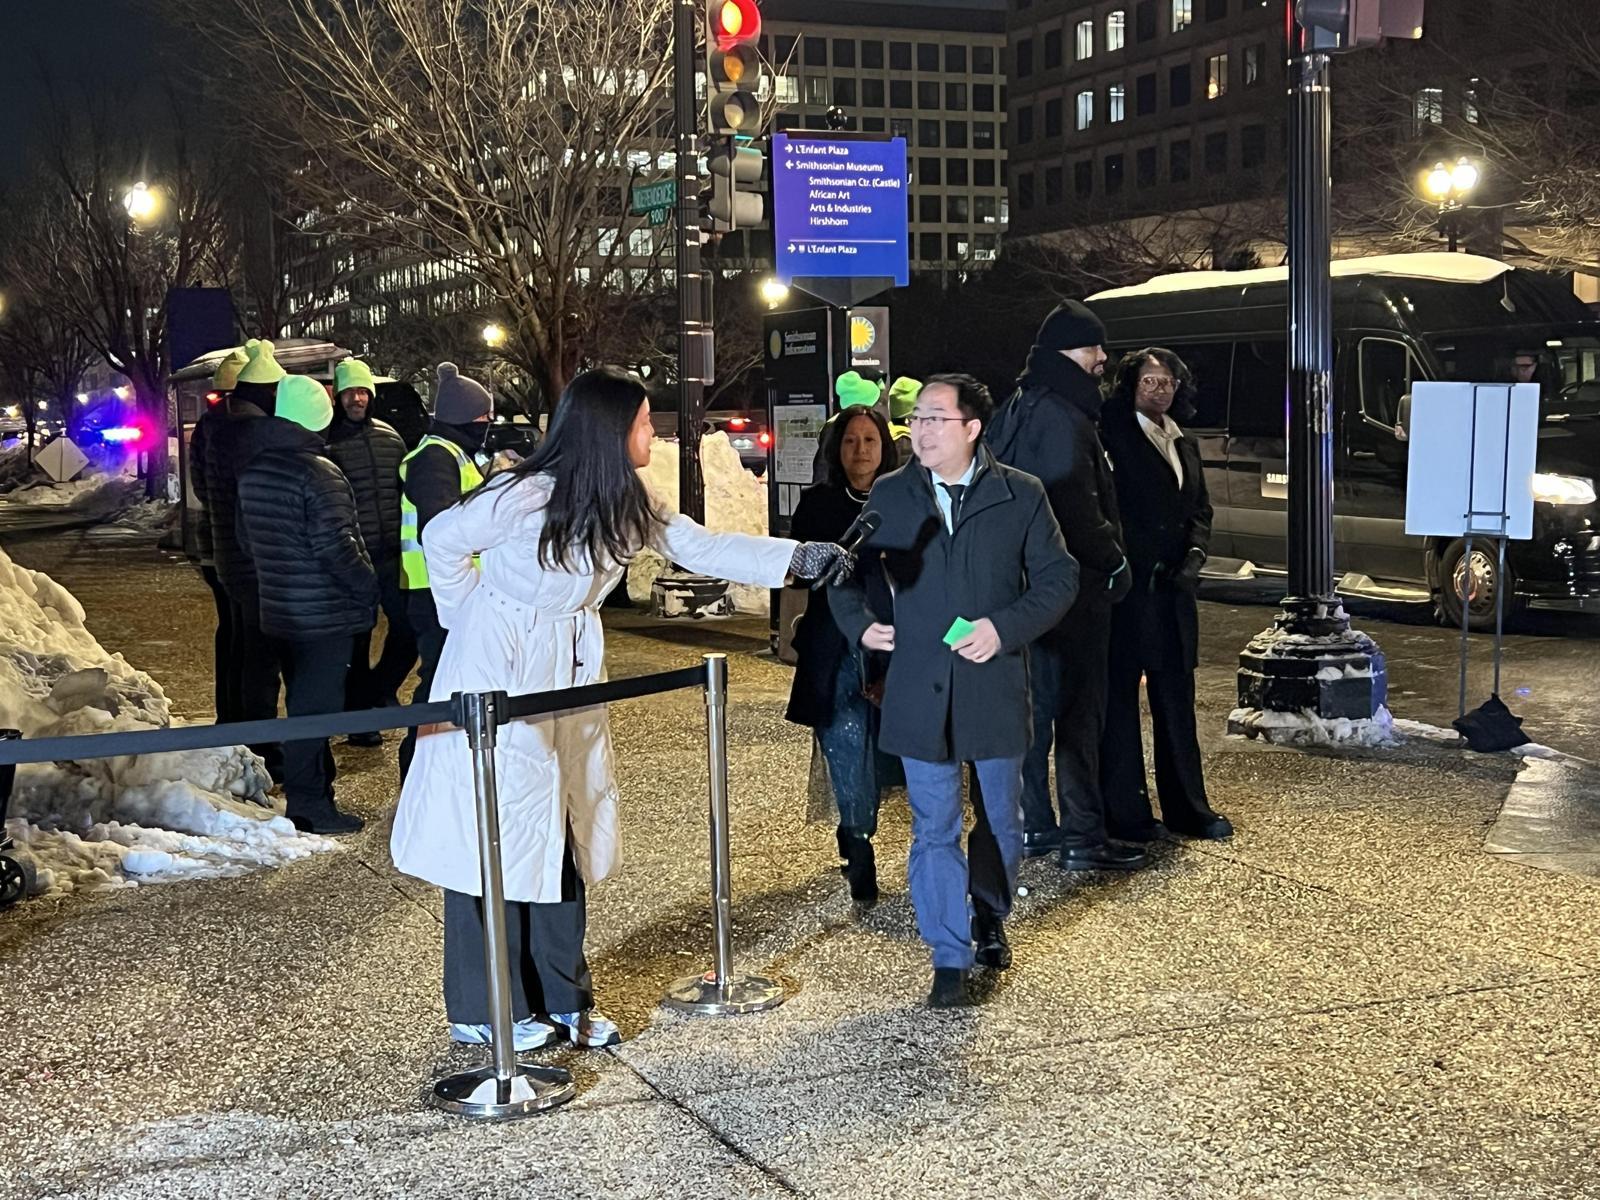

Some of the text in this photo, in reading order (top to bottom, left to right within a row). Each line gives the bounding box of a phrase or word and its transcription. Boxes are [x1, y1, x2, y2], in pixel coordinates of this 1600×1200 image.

[795, 144, 849, 155] L'Enfant Plaza
[796, 161, 884, 172] Smithsonian Museums
[809, 177, 901, 189] Smithsonian Ctr. (Castle)
[809, 190, 850, 200] African Art
[810, 204, 872, 214] Arts & Industries
[650, 208, 664, 223] 900
[810, 217, 849, 226] Hirshhorn
[807, 245, 858, 254] L'Enfant Plaza
[1266, 473, 1288, 485] SAMS
